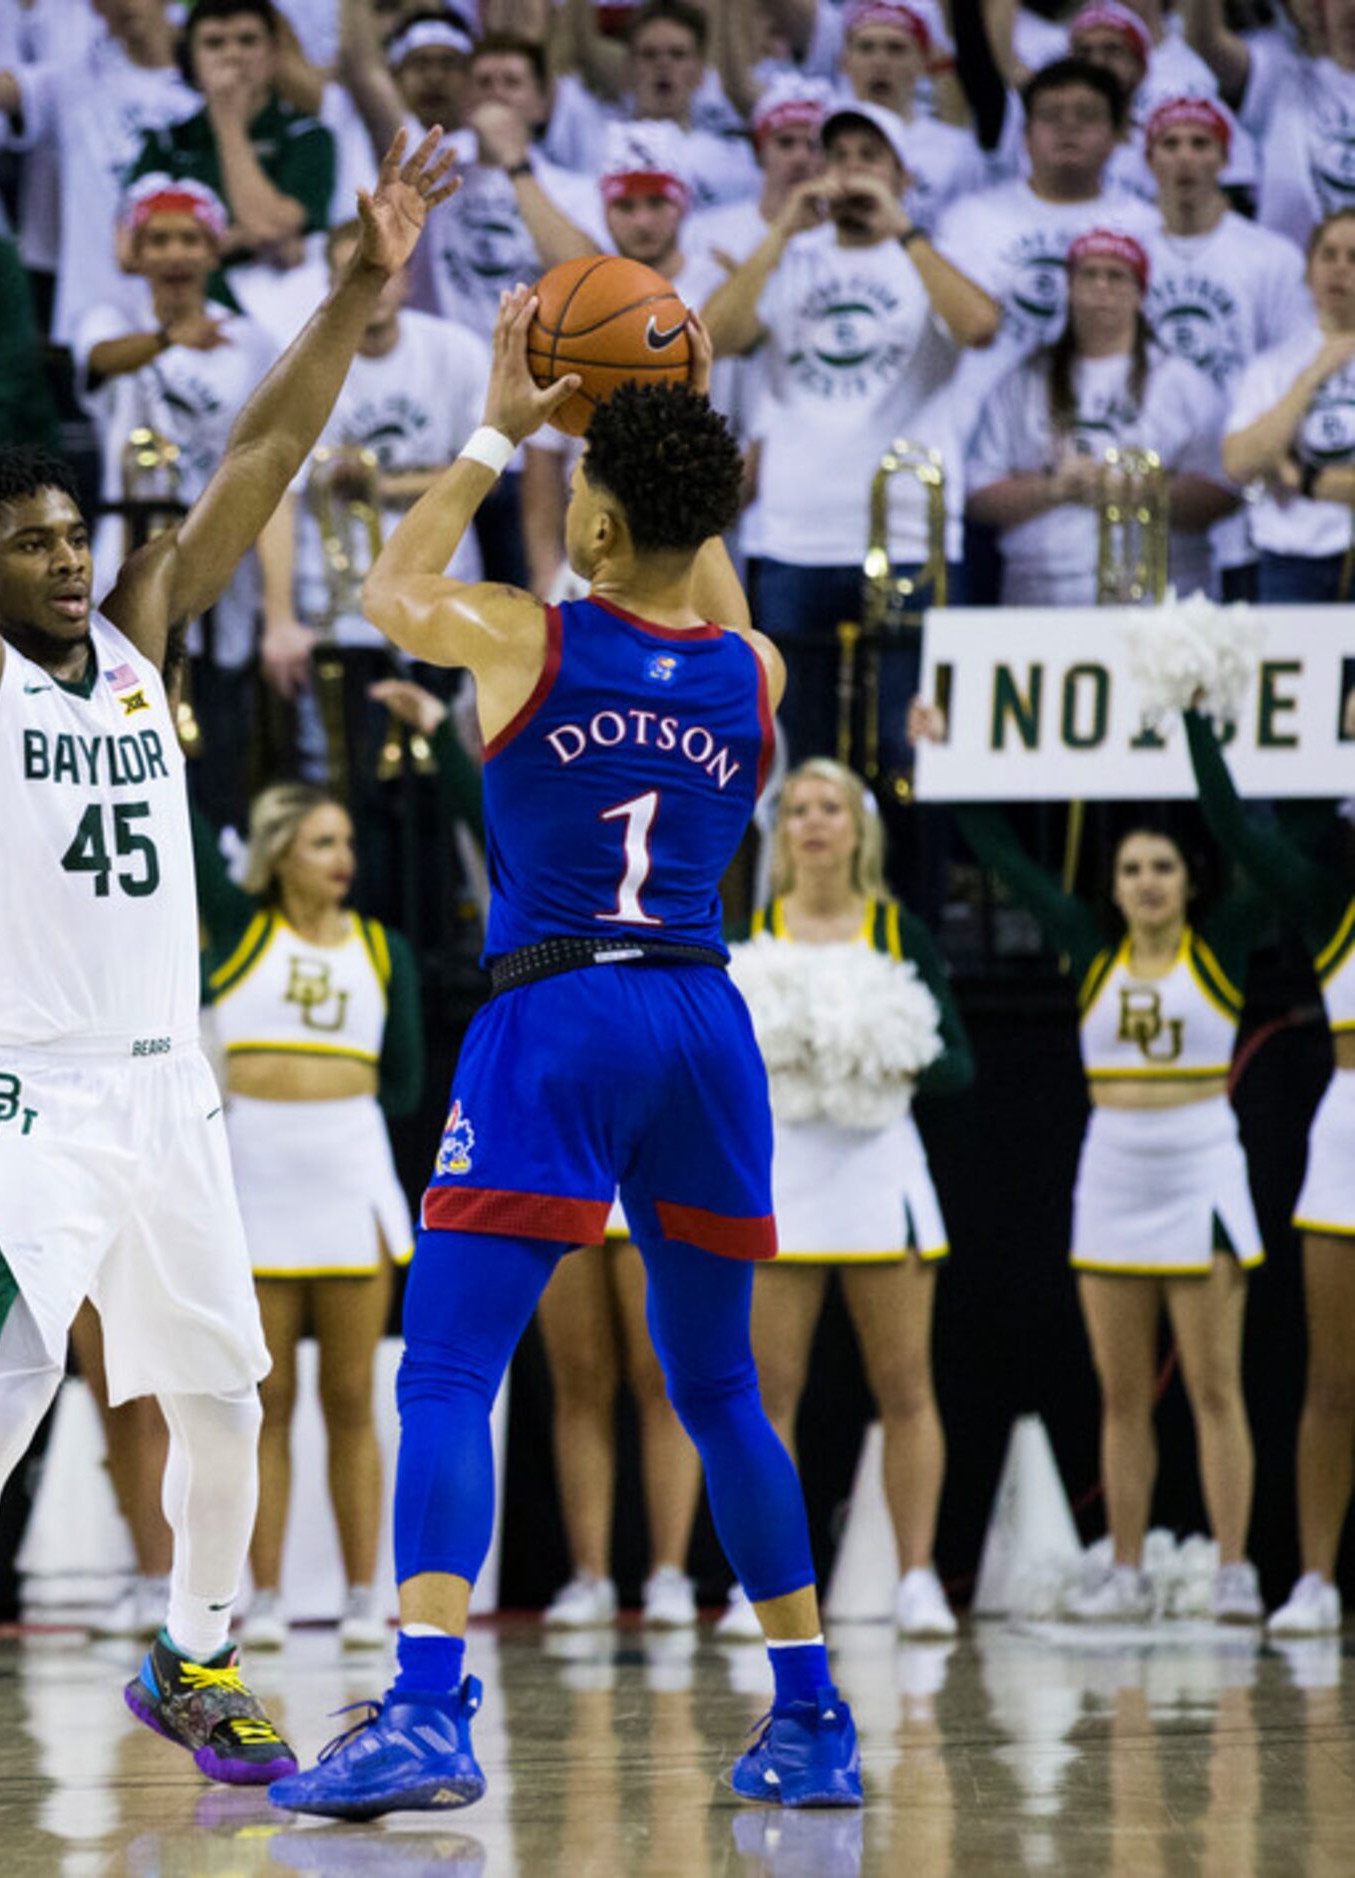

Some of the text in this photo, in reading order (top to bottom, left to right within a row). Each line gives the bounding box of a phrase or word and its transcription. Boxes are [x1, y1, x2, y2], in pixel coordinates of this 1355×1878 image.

[991, 659, 1302, 750] NOE
[23, 728, 169, 787] BAYLOR
[546, 710, 740, 789] DOTSON
[60, 801, 161, 898] 45
[595, 790, 663, 926] 1
[283, 956, 349, 1031] BU
[1118, 985, 1183, 1061] BU
[132, 1036, 172, 1057] BEARS
